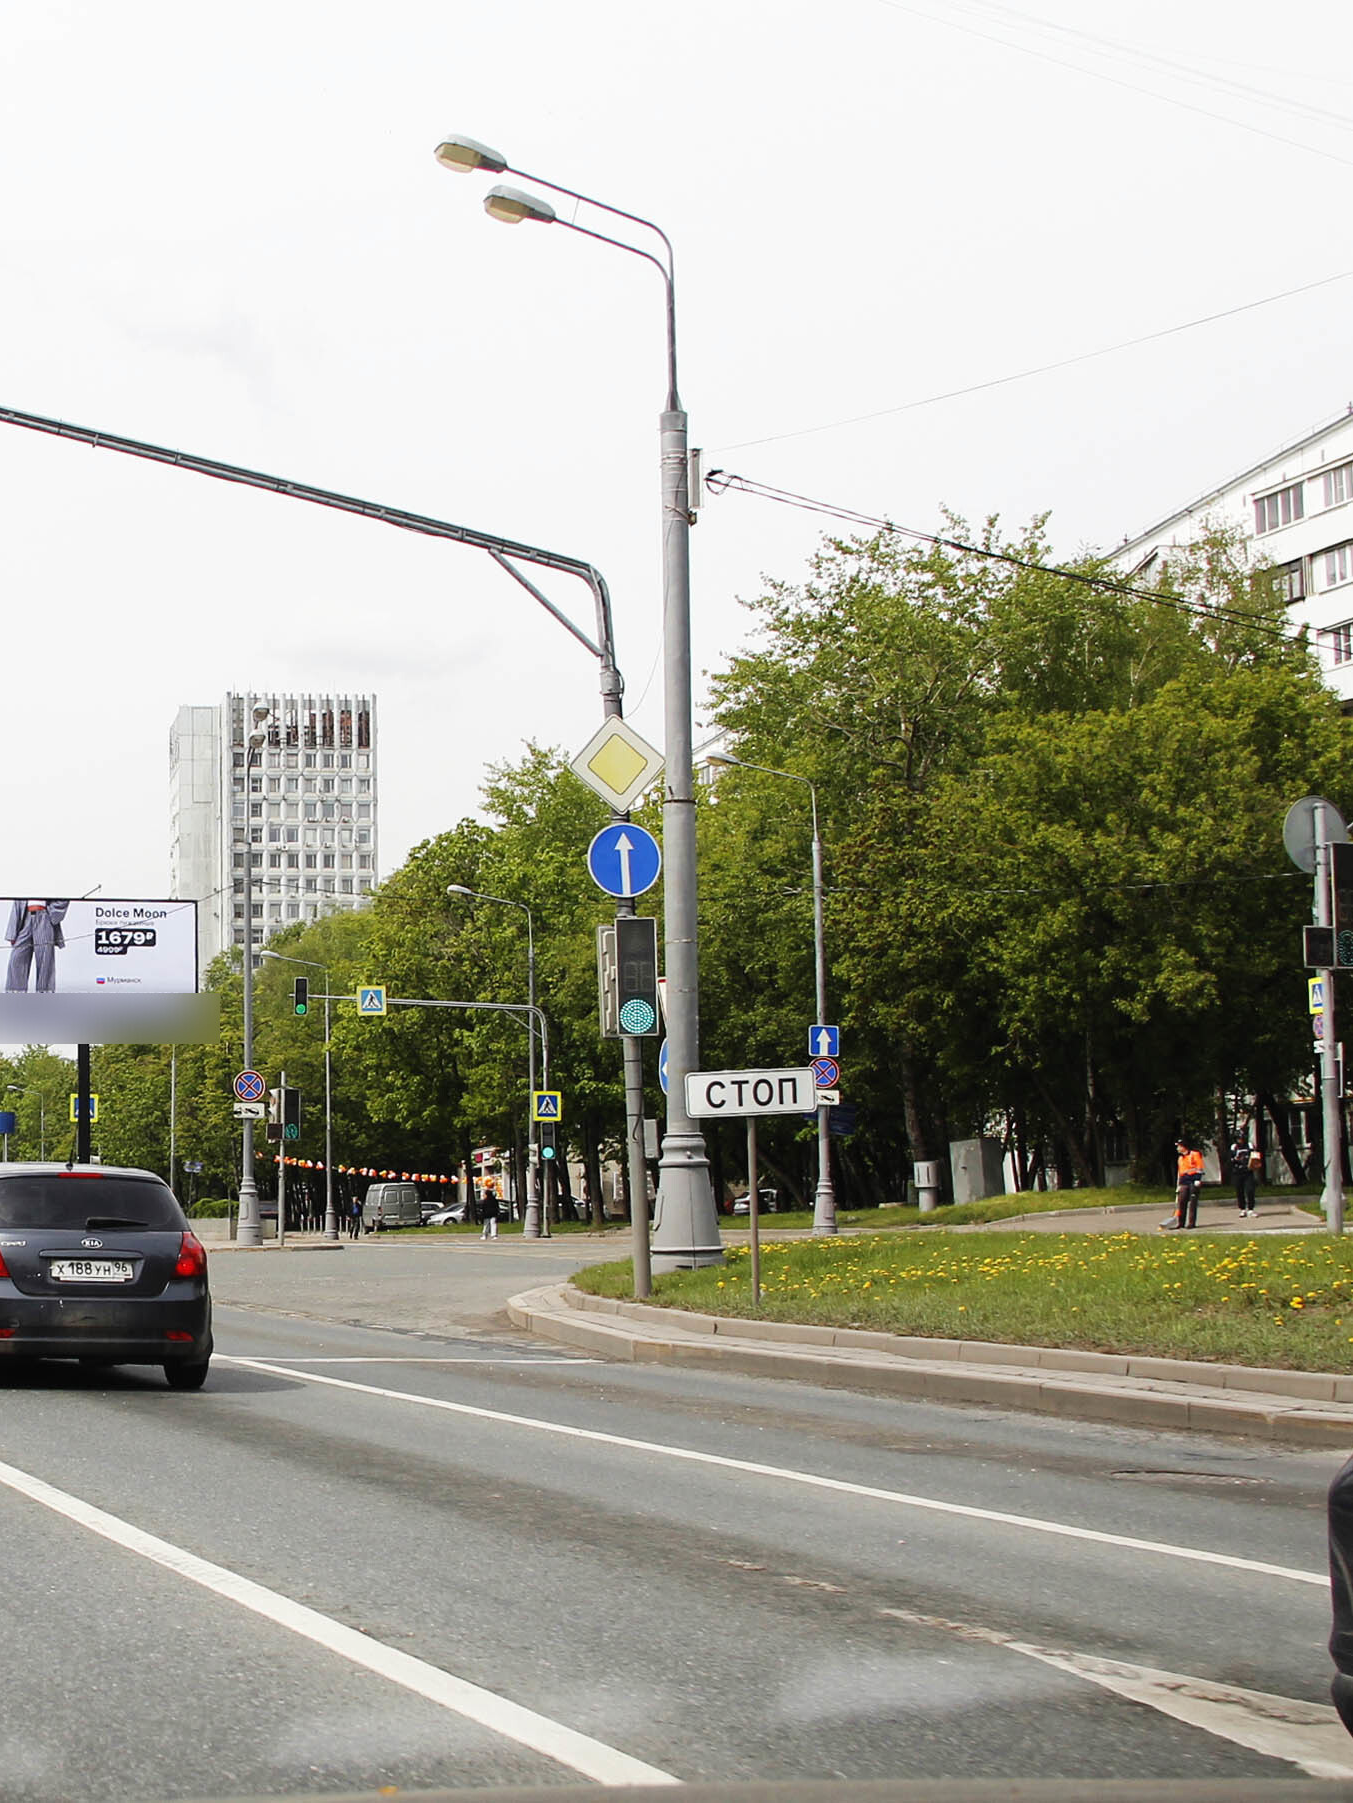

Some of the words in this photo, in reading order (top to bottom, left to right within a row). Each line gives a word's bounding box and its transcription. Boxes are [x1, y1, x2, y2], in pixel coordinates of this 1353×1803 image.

[95, 907, 130, 919] Dolce
[133, 907, 168, 919] Moon
[705, 1077, 798, 1109] СТОП
[84, 1239, 101, 1248] KIA
[114, 1262, 128, 1273] 96
